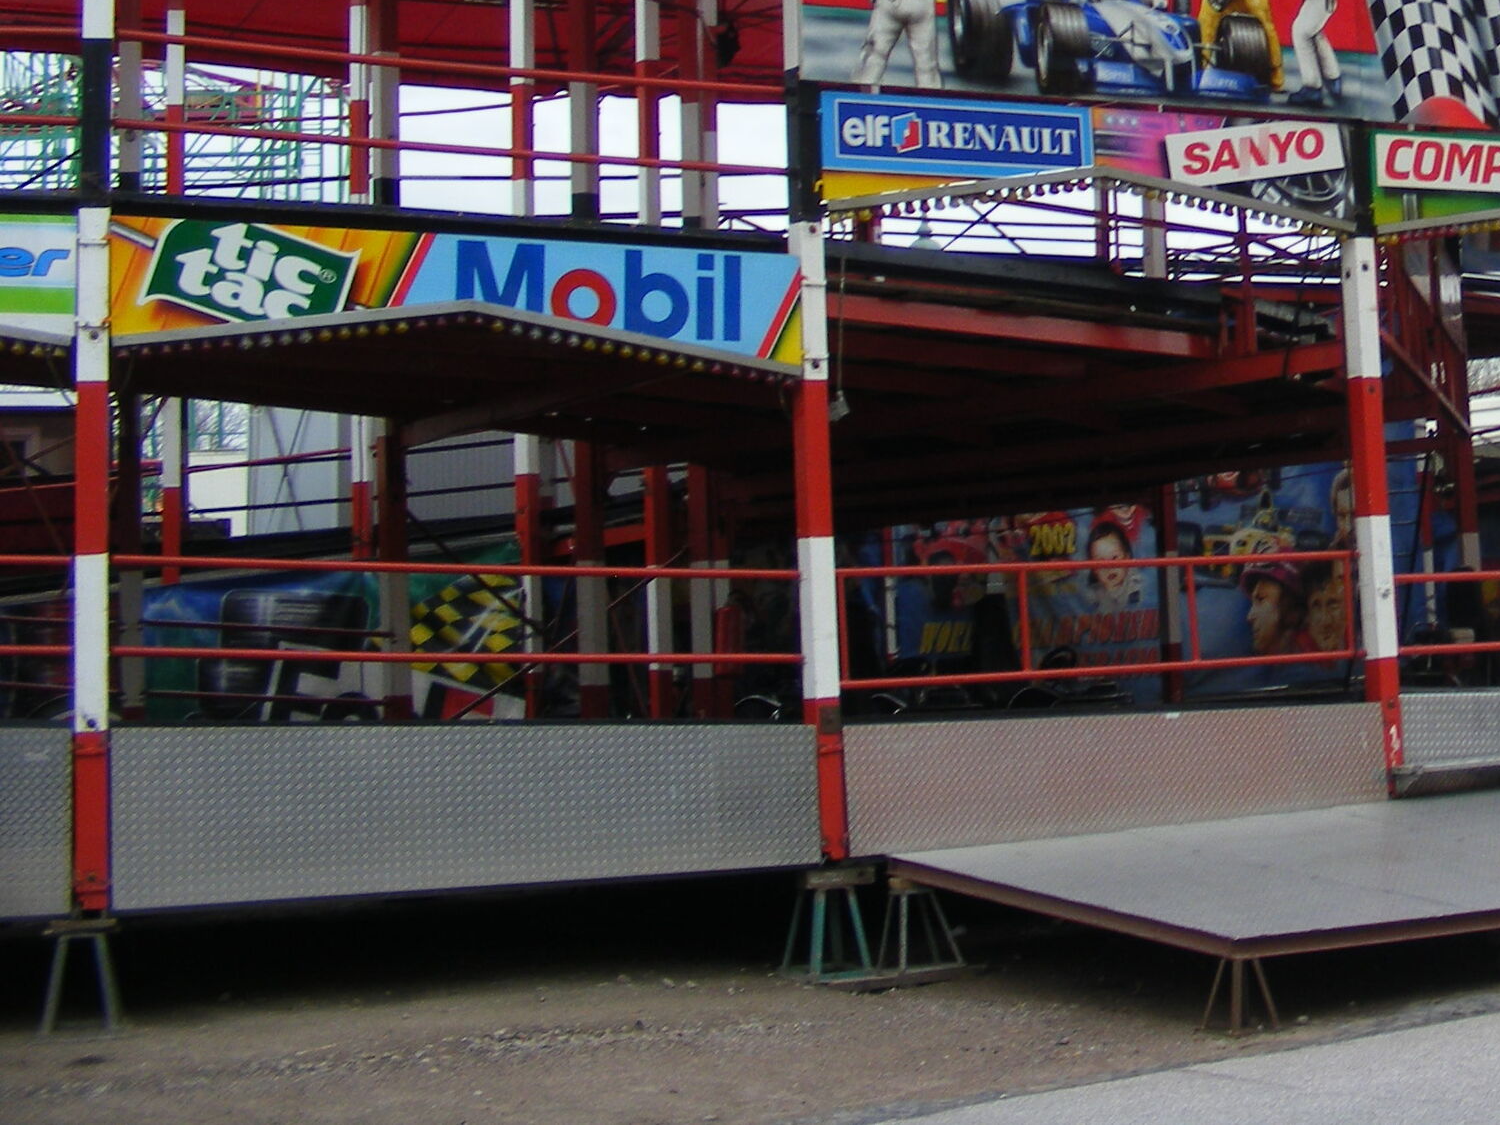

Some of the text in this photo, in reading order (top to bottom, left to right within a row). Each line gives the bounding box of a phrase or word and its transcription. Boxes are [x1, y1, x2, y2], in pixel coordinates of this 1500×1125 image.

[842, 113, 1077, 157] elf RENAULT
[1182, 128, 1325, 176] SANYO
[175, 248, 311, 319] tac
[211, 222, 322, 295] tic
[454, 239, 742, 343] Mobil
